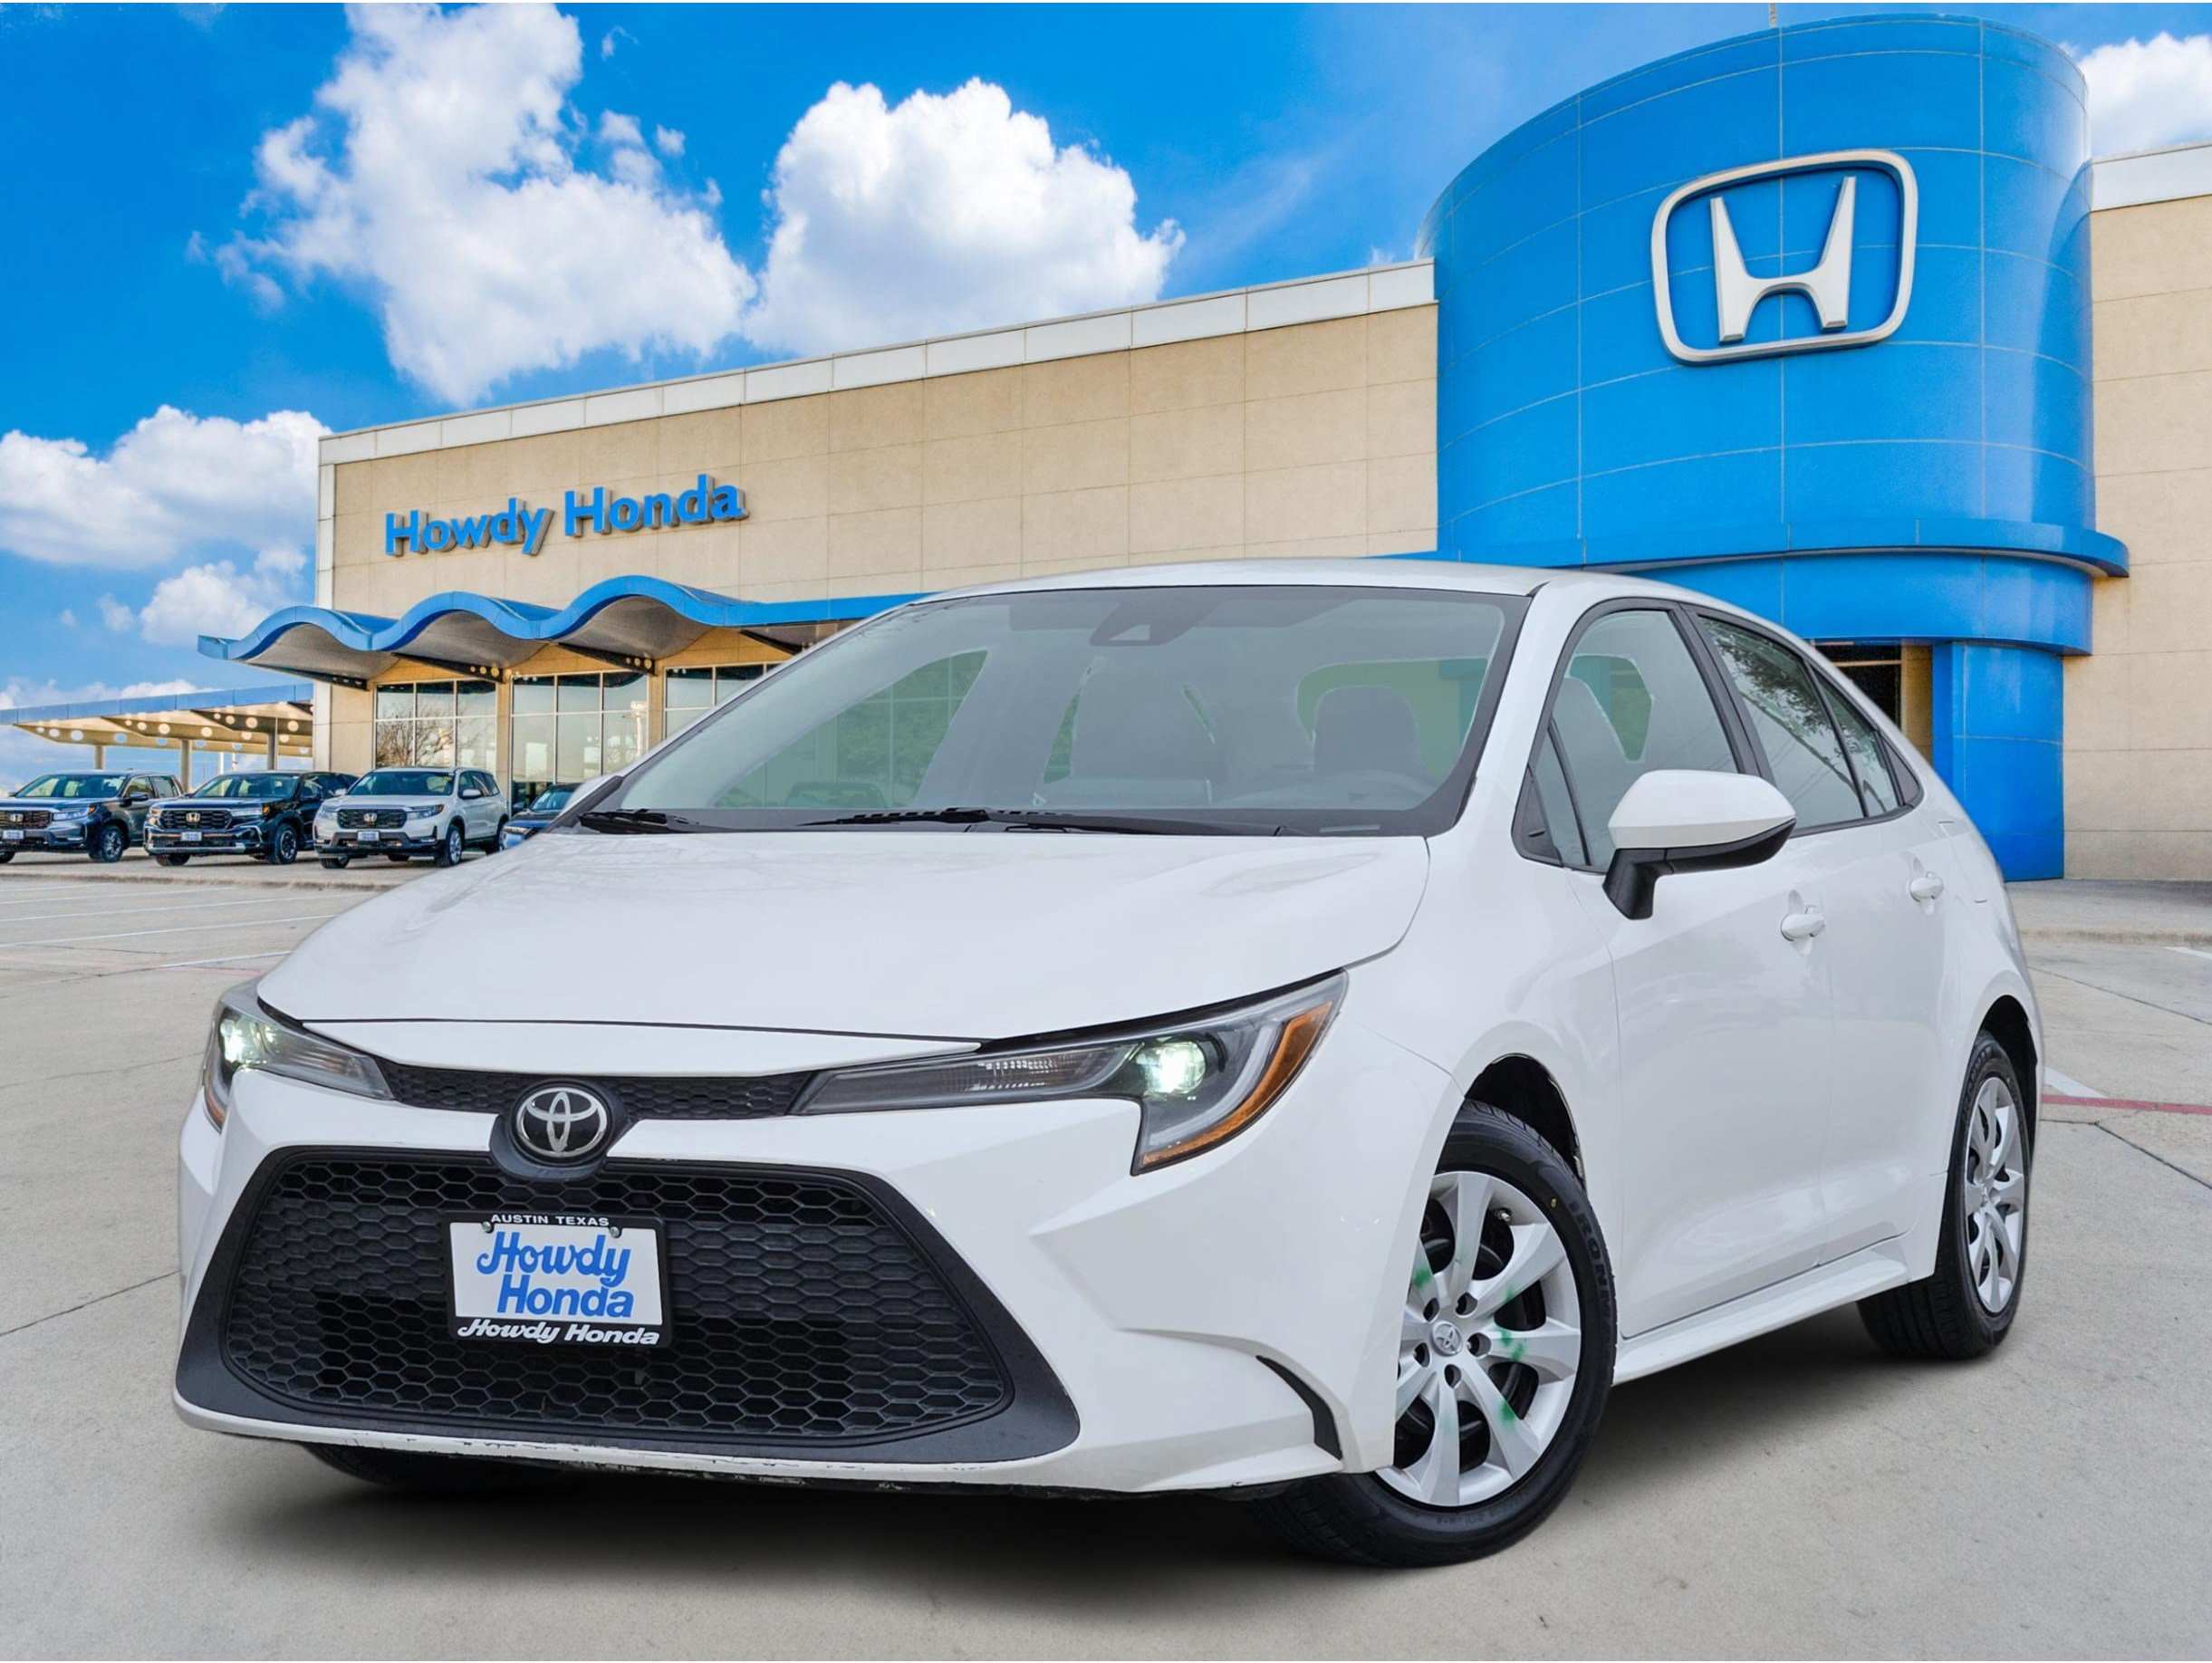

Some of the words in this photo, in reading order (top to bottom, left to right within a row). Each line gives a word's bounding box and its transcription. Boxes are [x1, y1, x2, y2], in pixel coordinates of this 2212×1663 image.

[385, 497, 554, 555] Howdy
[564, 474, 748, 537] Honda
[491, 1214, 549, 1225] AUSTIN
[555, 1216, 610, 1226] TEXAS
[476, 1231, 631, 1287] Howdy
[497, 1274, 634, 1318] Honda
[457, 1319, 561, 1344] Howdy
[564, 1324, 659, 1344] Honda
